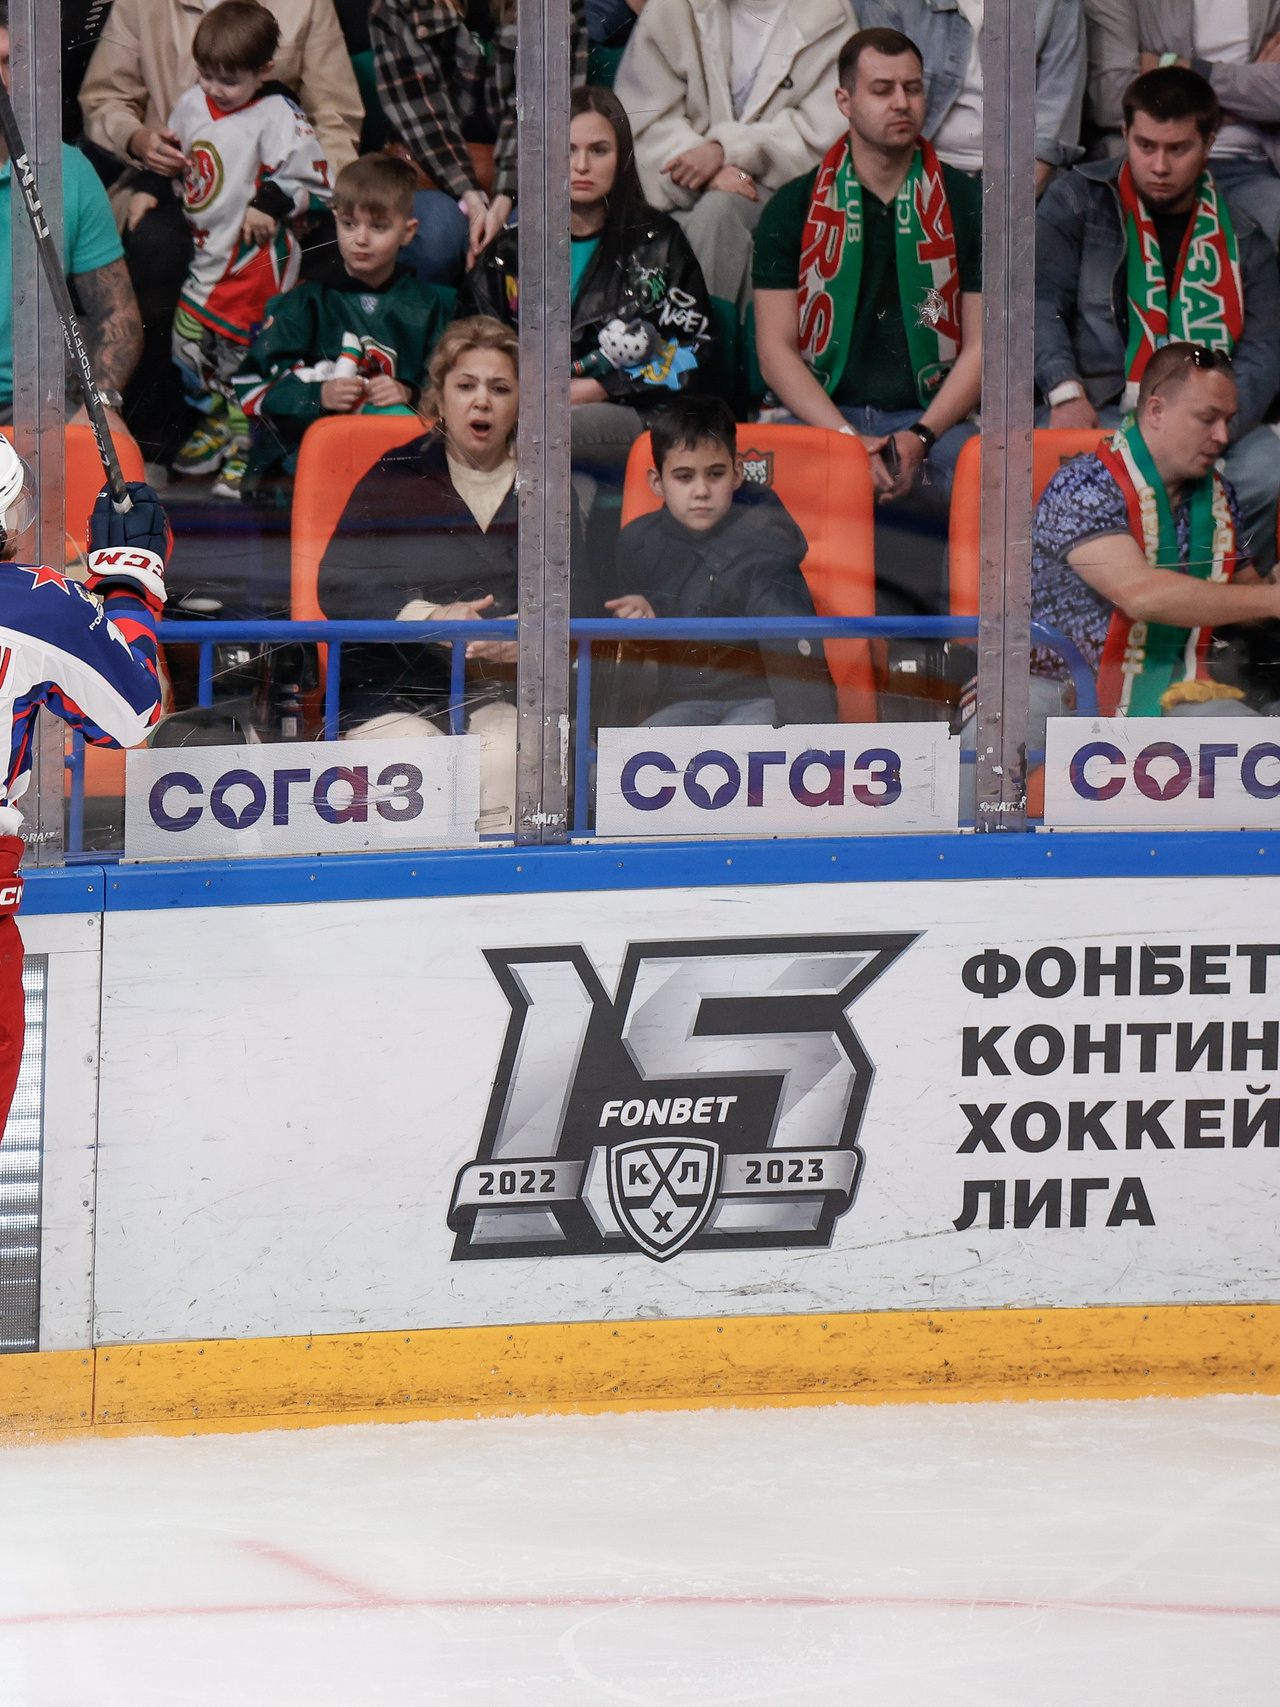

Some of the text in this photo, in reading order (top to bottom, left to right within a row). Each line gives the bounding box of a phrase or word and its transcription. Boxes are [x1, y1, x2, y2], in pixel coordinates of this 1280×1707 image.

[896, 179, 911, 234] ICE
[149, 762, 424, 832] согаз
[620, 747, 902, 811] согаз
[962, 943, 1280, 999] ФОНБЕТ
[962, 1020, 1280, 1077] КОНТИН
[599, 1095, 738, 1129] FONBET
[957, 1083, 1280, 1154] ХОККЕЙ
[478, 1168, 556, 1196] 2022
[745, 1158, 826, 1185] 2023
[954, 1177, 1155, 1232] ЛИГА
